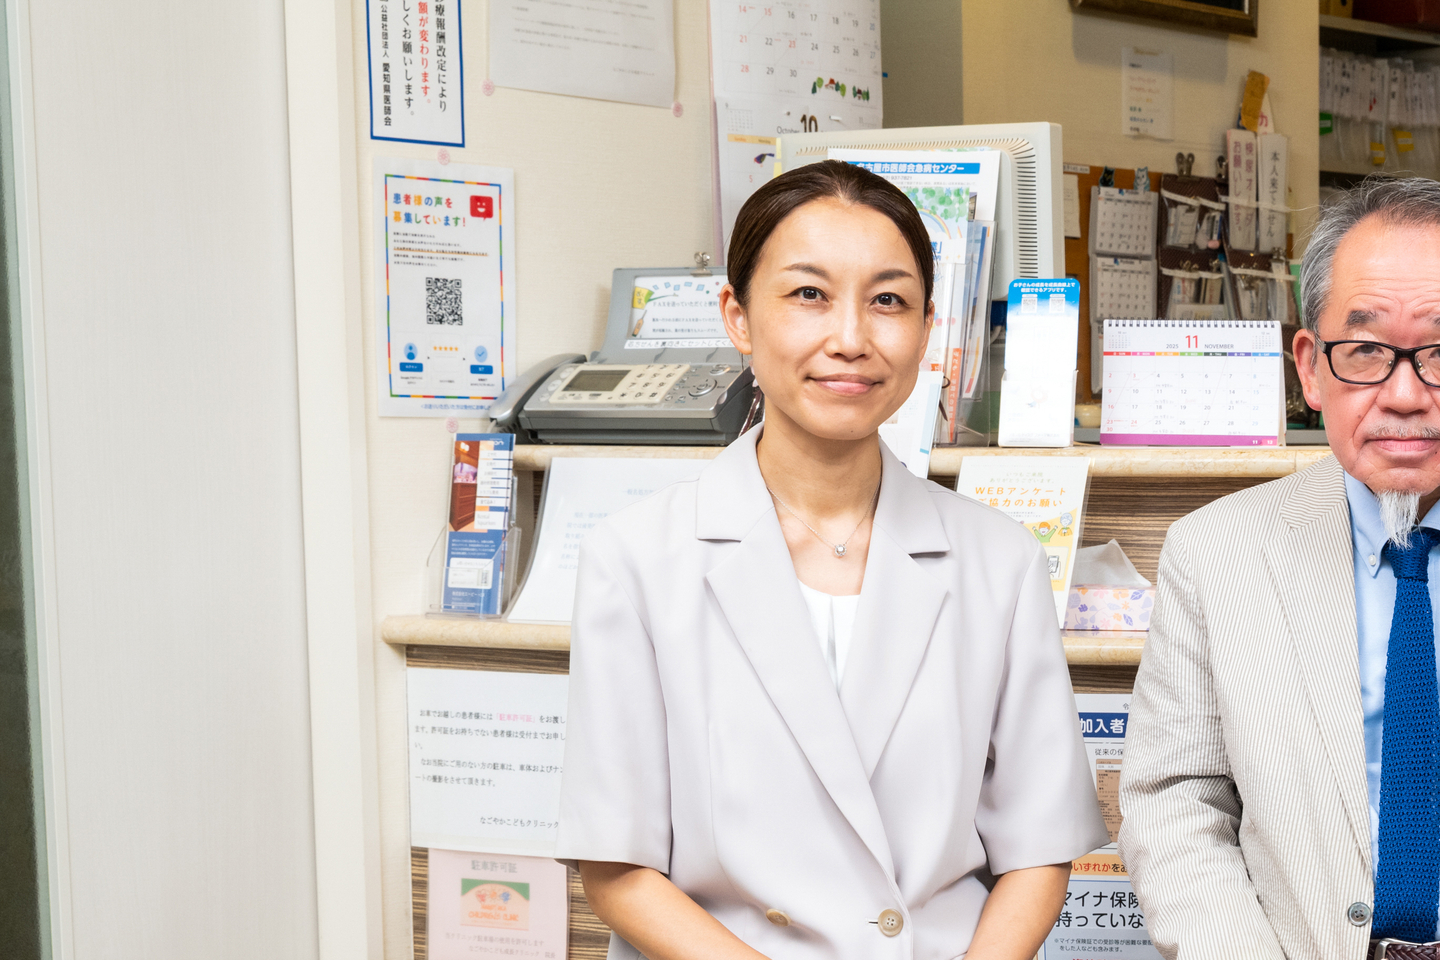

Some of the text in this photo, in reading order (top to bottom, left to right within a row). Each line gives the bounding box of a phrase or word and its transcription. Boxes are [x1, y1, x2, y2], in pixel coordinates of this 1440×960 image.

[738, 5, 747, 13] 14
[764, 8, 772, 16] 15
[787, 11, 795, 19] 16
[810, 14, 817, 22] 17
[832, 17, 839, 25] 18
[418, 1, 431, 103] 額が変わります。
[739, 35, 747, 43] 21
[765, 38, 773, 46] 22
[788, 40, 796, 48] 23
[811, 43, 818, 51] 24
[833, 46, 840, 54] 25
[852, 48, 859, 56] 26
[434, 0, 447, 112] 療報酬改定により
[380, 4, 391, 126] 公益社団法人 愛知県医師会
[740, 65, 749, 73] 28
[766, 67, 774, 75] 29
[393, 193, 453, 208] 患者様の声を
[1185, 335, 1198, 348] 11
[975, 487, 1066, 496] WEBアンケート
[1080, 718, 1125, 734] 加入者
[480, 816, 559, 829] なごやかこどもクリニック
[471, 860, 517, 873] 駐車許可証
[1056, 911, 1144, 929] 持っていな
[1060, 945, 1123, 953] をした人なども含みます。
